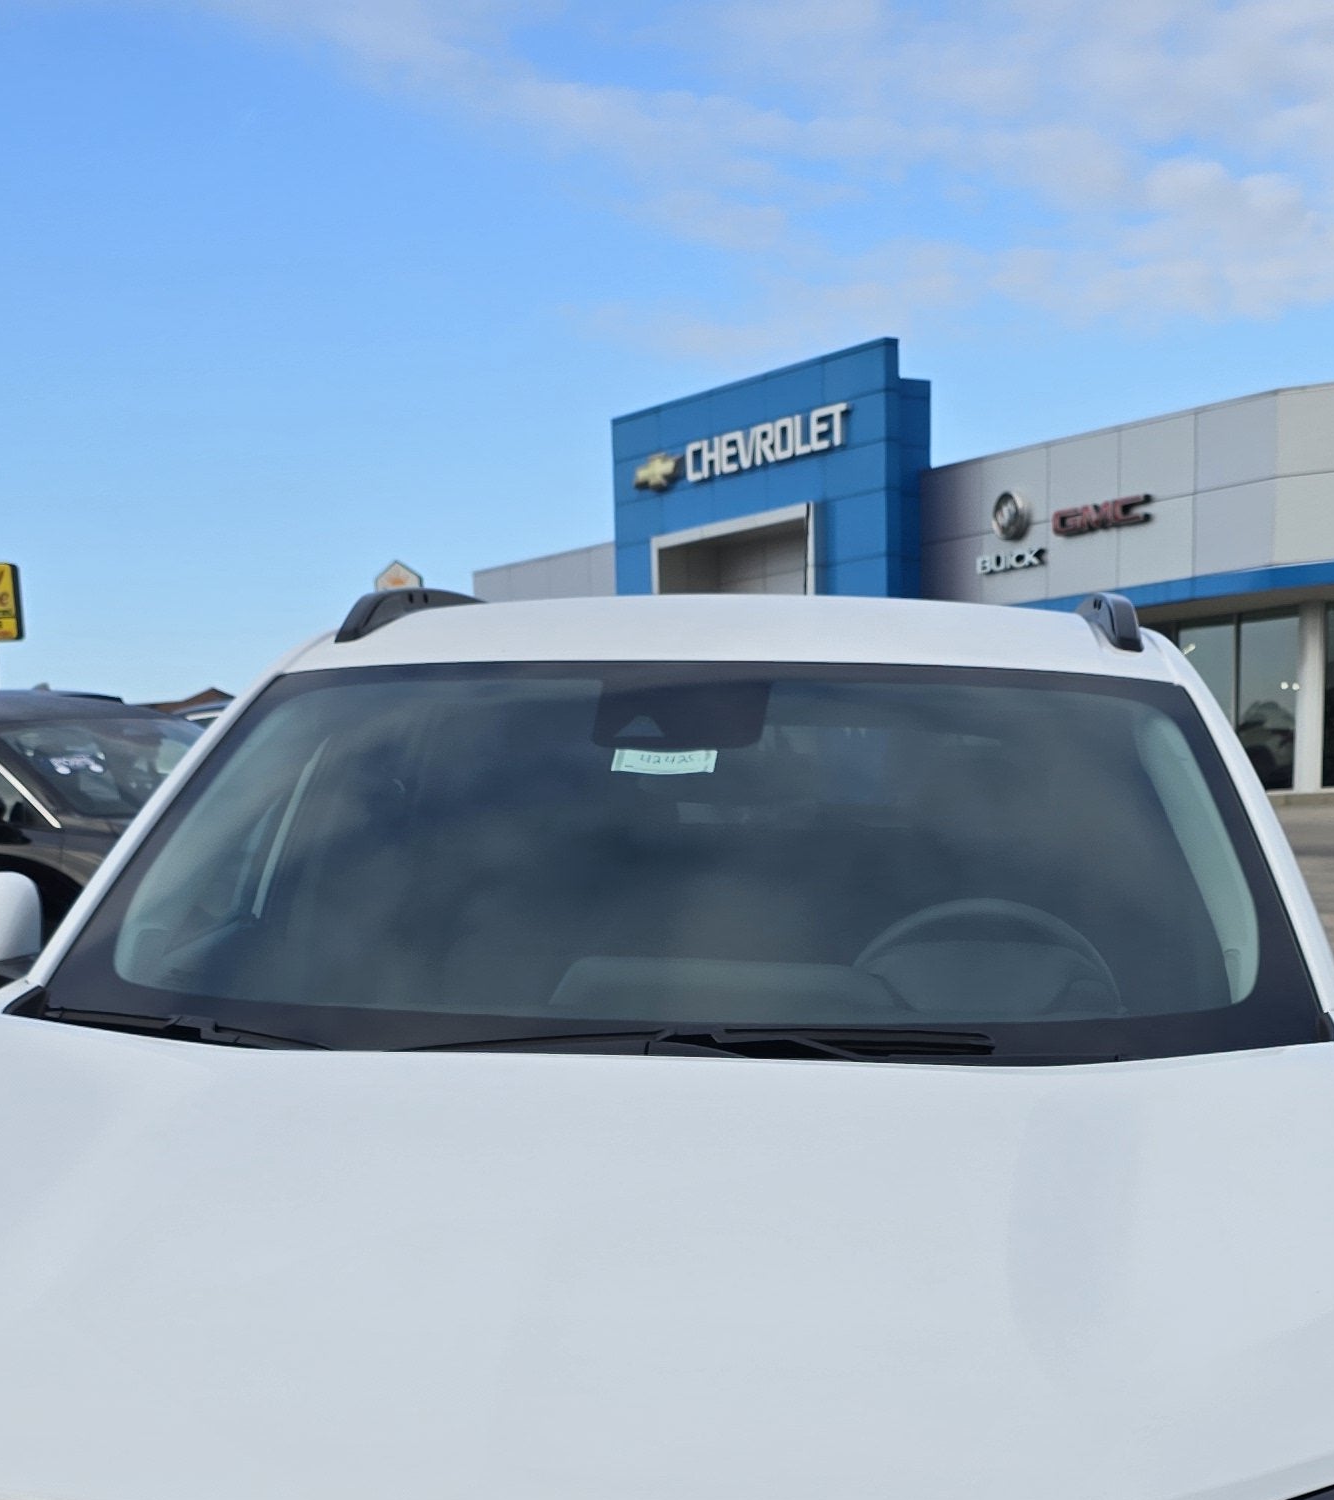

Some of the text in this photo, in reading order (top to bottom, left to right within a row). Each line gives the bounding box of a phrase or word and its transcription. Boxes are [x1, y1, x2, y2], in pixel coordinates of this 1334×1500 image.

[685, 402, 851, 482] CHEVROLET
[1052, 494, 1153, 536] GMC
[975, 548, 1047, 575] BUICK
